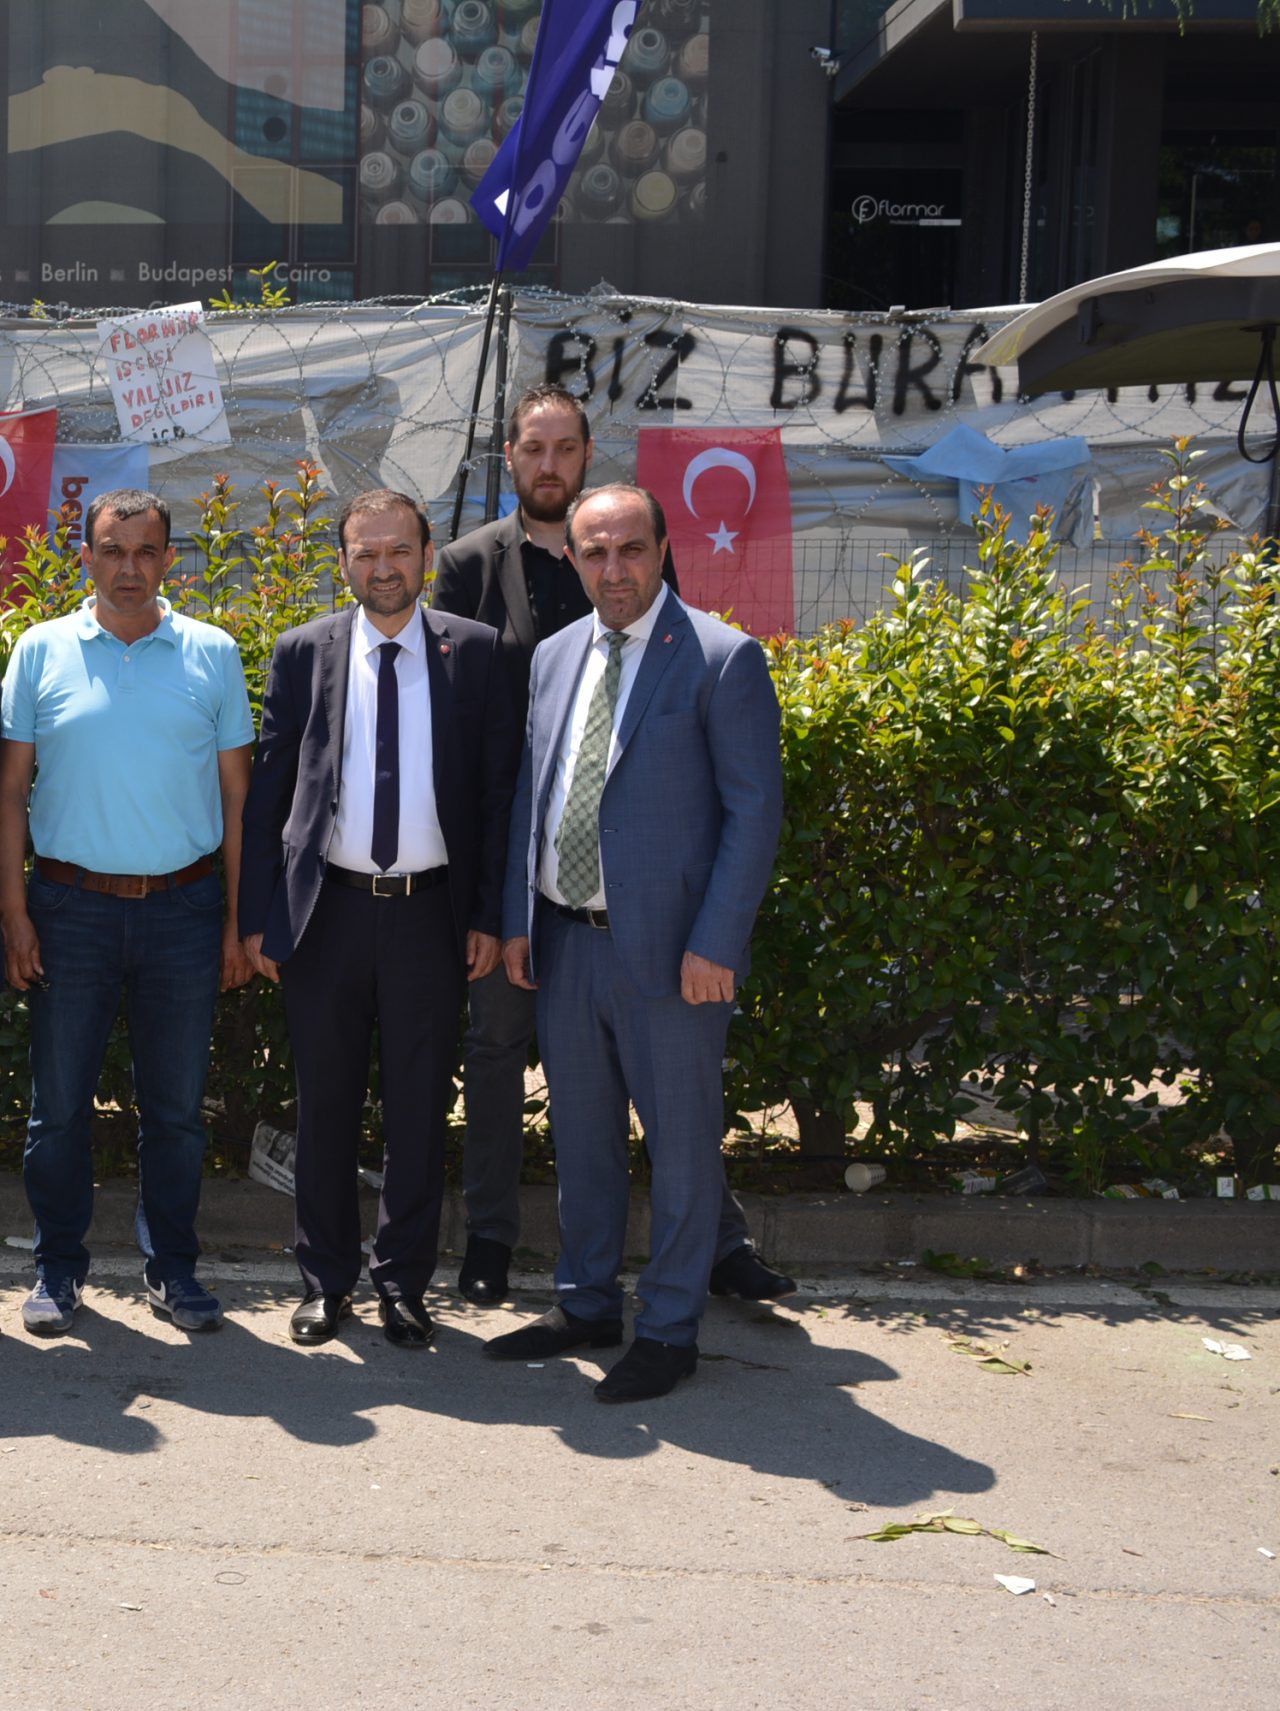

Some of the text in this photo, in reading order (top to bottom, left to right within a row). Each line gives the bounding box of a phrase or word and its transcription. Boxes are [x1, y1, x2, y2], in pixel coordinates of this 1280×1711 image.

[878, 199, 945, 216] flormar
[41, 262, 99, 283] Berlin
[138, 262, 234, 287] Budapest
[273, 262, 332, 283] Cairo
